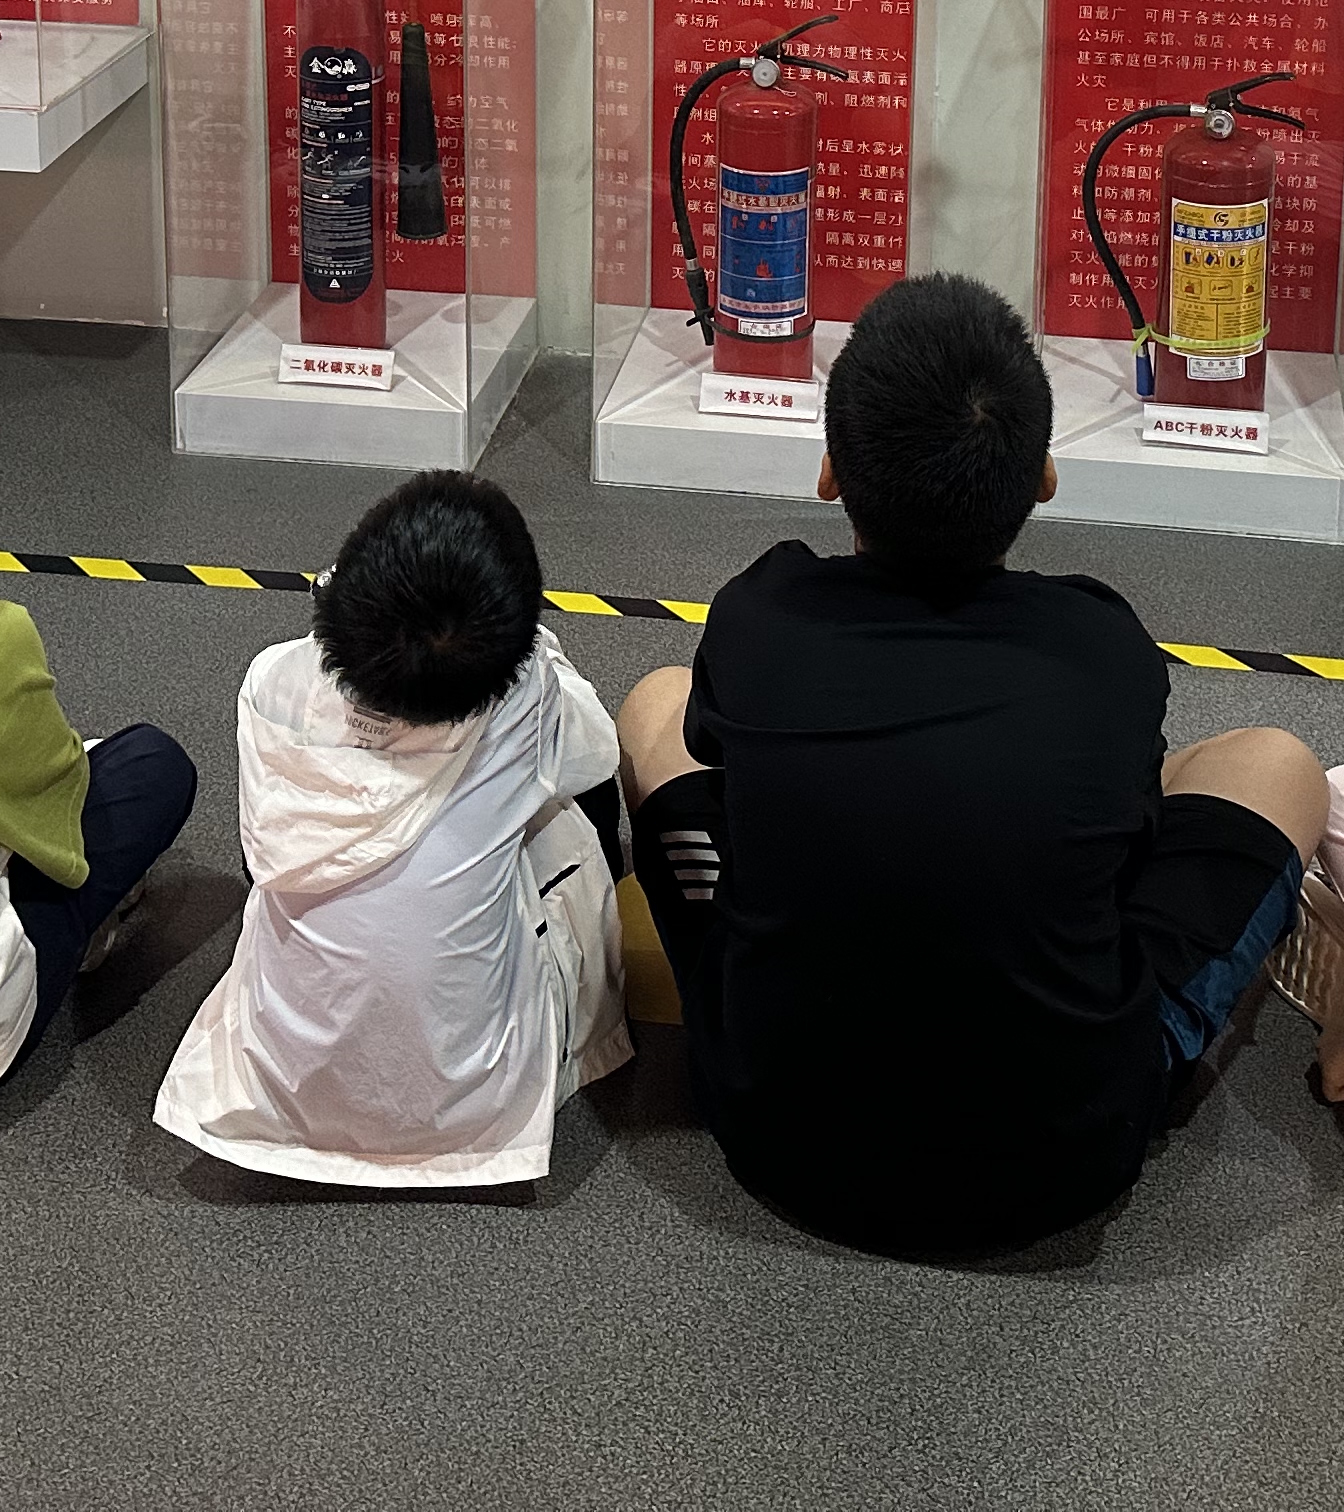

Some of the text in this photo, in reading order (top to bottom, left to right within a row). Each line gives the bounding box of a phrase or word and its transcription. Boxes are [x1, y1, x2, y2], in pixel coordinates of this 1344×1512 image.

[289, 357, 384, 378] 二氧化碳灭火器
[723, 389, 794, 409] 水基灭火器
[1153, 417, 1259, 441] ABC干粉灭火器
